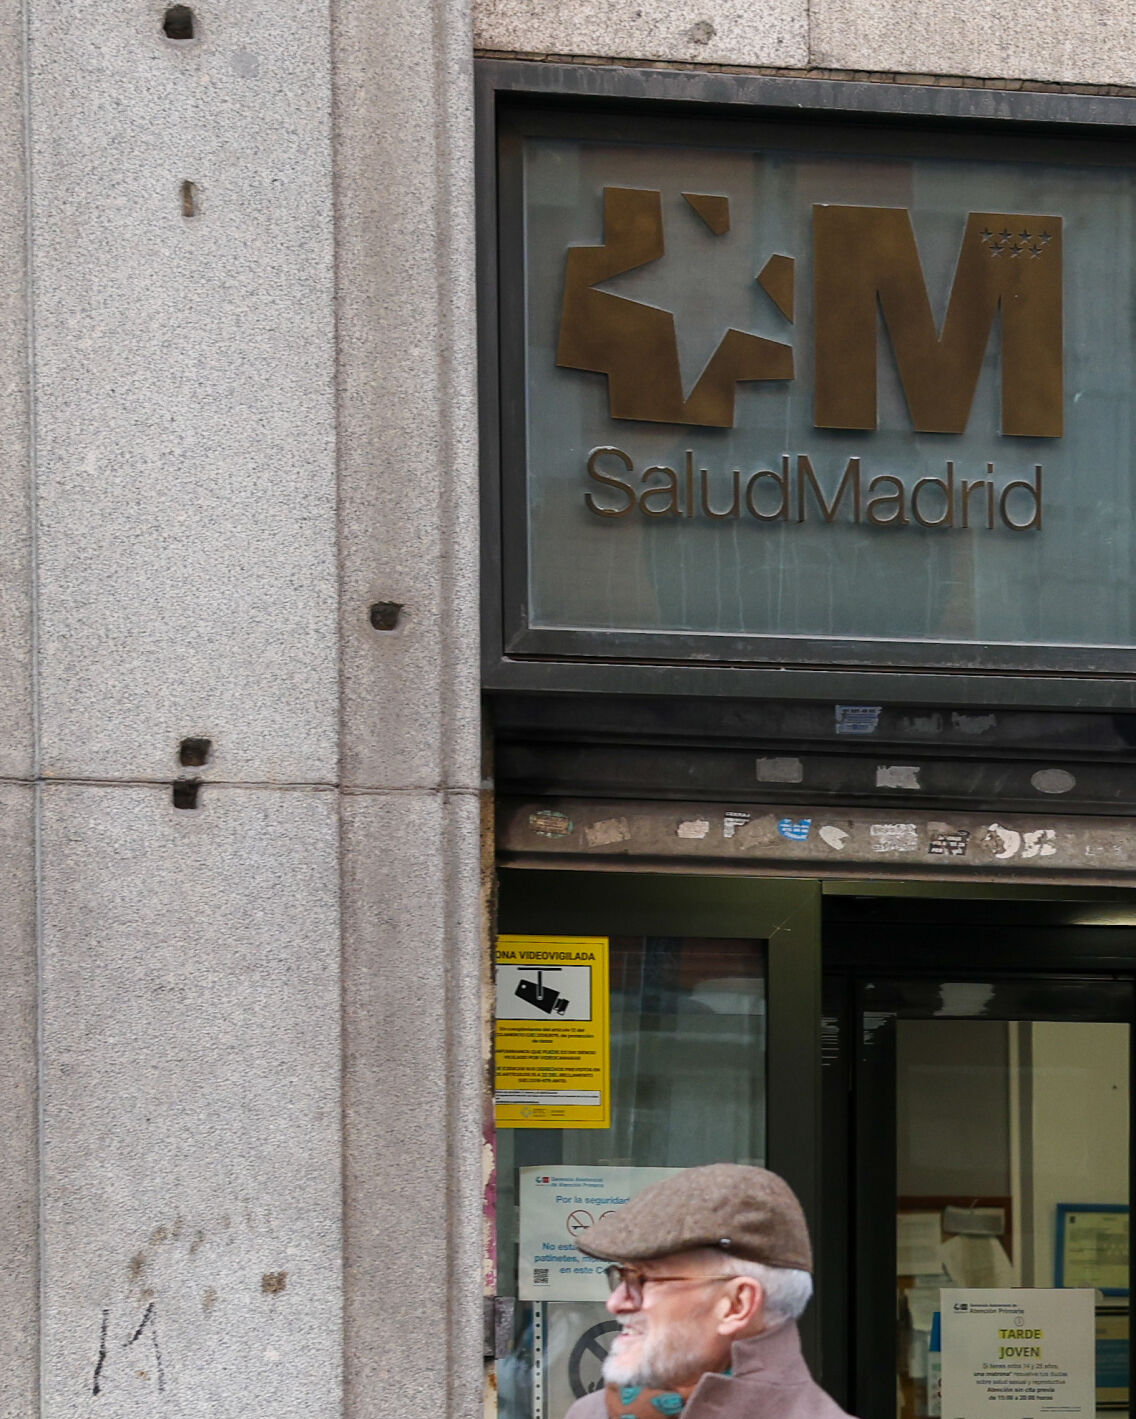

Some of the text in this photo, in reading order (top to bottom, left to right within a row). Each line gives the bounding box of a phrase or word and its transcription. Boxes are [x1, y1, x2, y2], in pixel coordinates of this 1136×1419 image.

[583, 445, 1043, 532] SaludMadrid
[495, 950, 596, 961] ONA VIDEOVIGILADA
[556, 1195, 572, 1204] Por
[574, 1195, 582, 1204] la
[542, 1242, 555, 1251] No
[574, 1266, 593, 1274] este
[999, 1329, 1041, 1339] TARDE
[998, 1346, 1040, 1359] JOVEN
